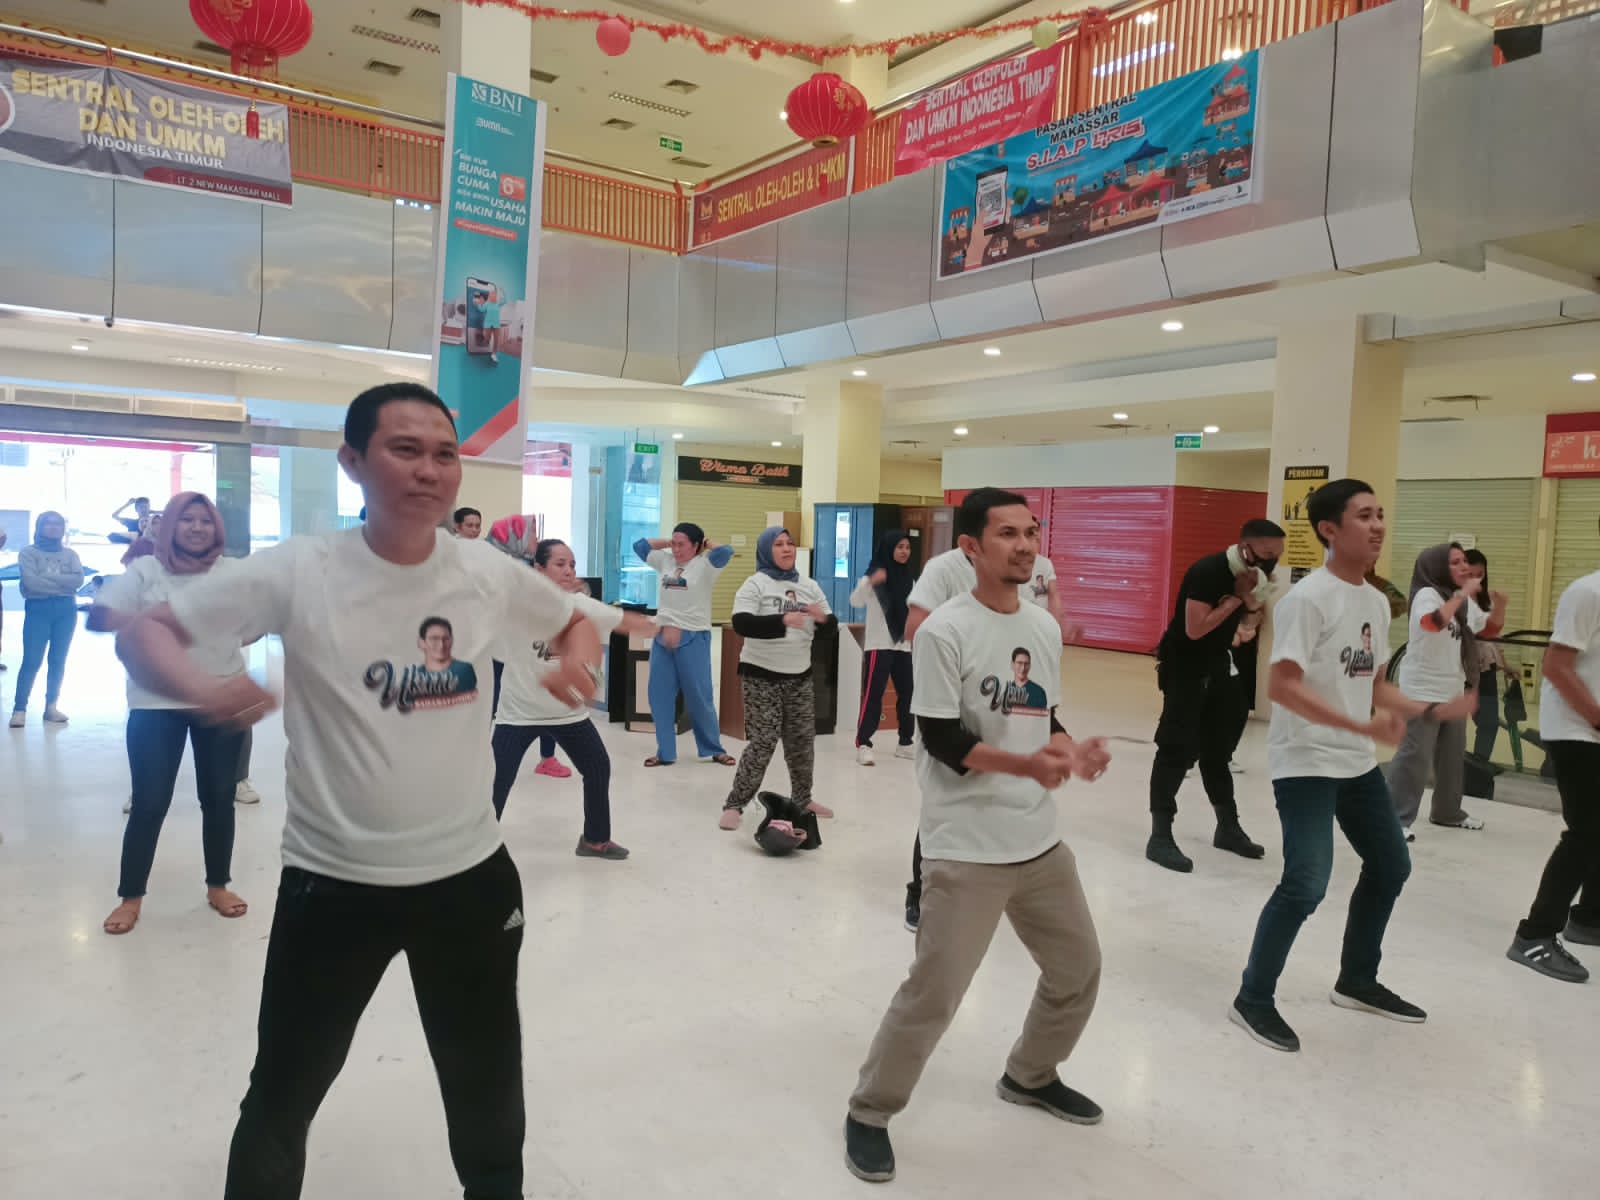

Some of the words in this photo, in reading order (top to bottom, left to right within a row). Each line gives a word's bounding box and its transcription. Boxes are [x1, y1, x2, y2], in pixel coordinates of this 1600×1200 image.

[12, 68, 140, 113] SENTRAL
[490, 88, 522, 113] BNI
[905, 115, 925, 144] DAN
[927, 104, 957, 135] UMKM
[961, 81, 1014, 124] INDONESIA
[1035, 115, 1076, 138] PASAR
[1049, 110, 1120, 144] MAKASSAR
[80, 107, 137, 142] DAN
[145, 120, 227, 159] UMKM
[1026, 137, 1088, 170] S.I.A.P
[1091, 116, 1146, 150] QRIS
[87, 133, 172, 161] INDONESIA
[174, 151, 224, 169] TIMUR
[457, 174, 490, 192] CUMA
[458, 161, 498, 181] BUNGA
[196, 180, 214, 191] NEW
[216, 183, 260, 197] MAKASSAR
[261, 189, 281, 201] MALL
[490, 196, 527, 215] USAHA
[717, 193, 754, 224] SENTRAL
[755, 167, 805, 210] OLEH-OLEH
[806, 165, 814, 191] &
[455, 200, 493, 218] MAKIN
[495, 209, 527, 226] MAJU
